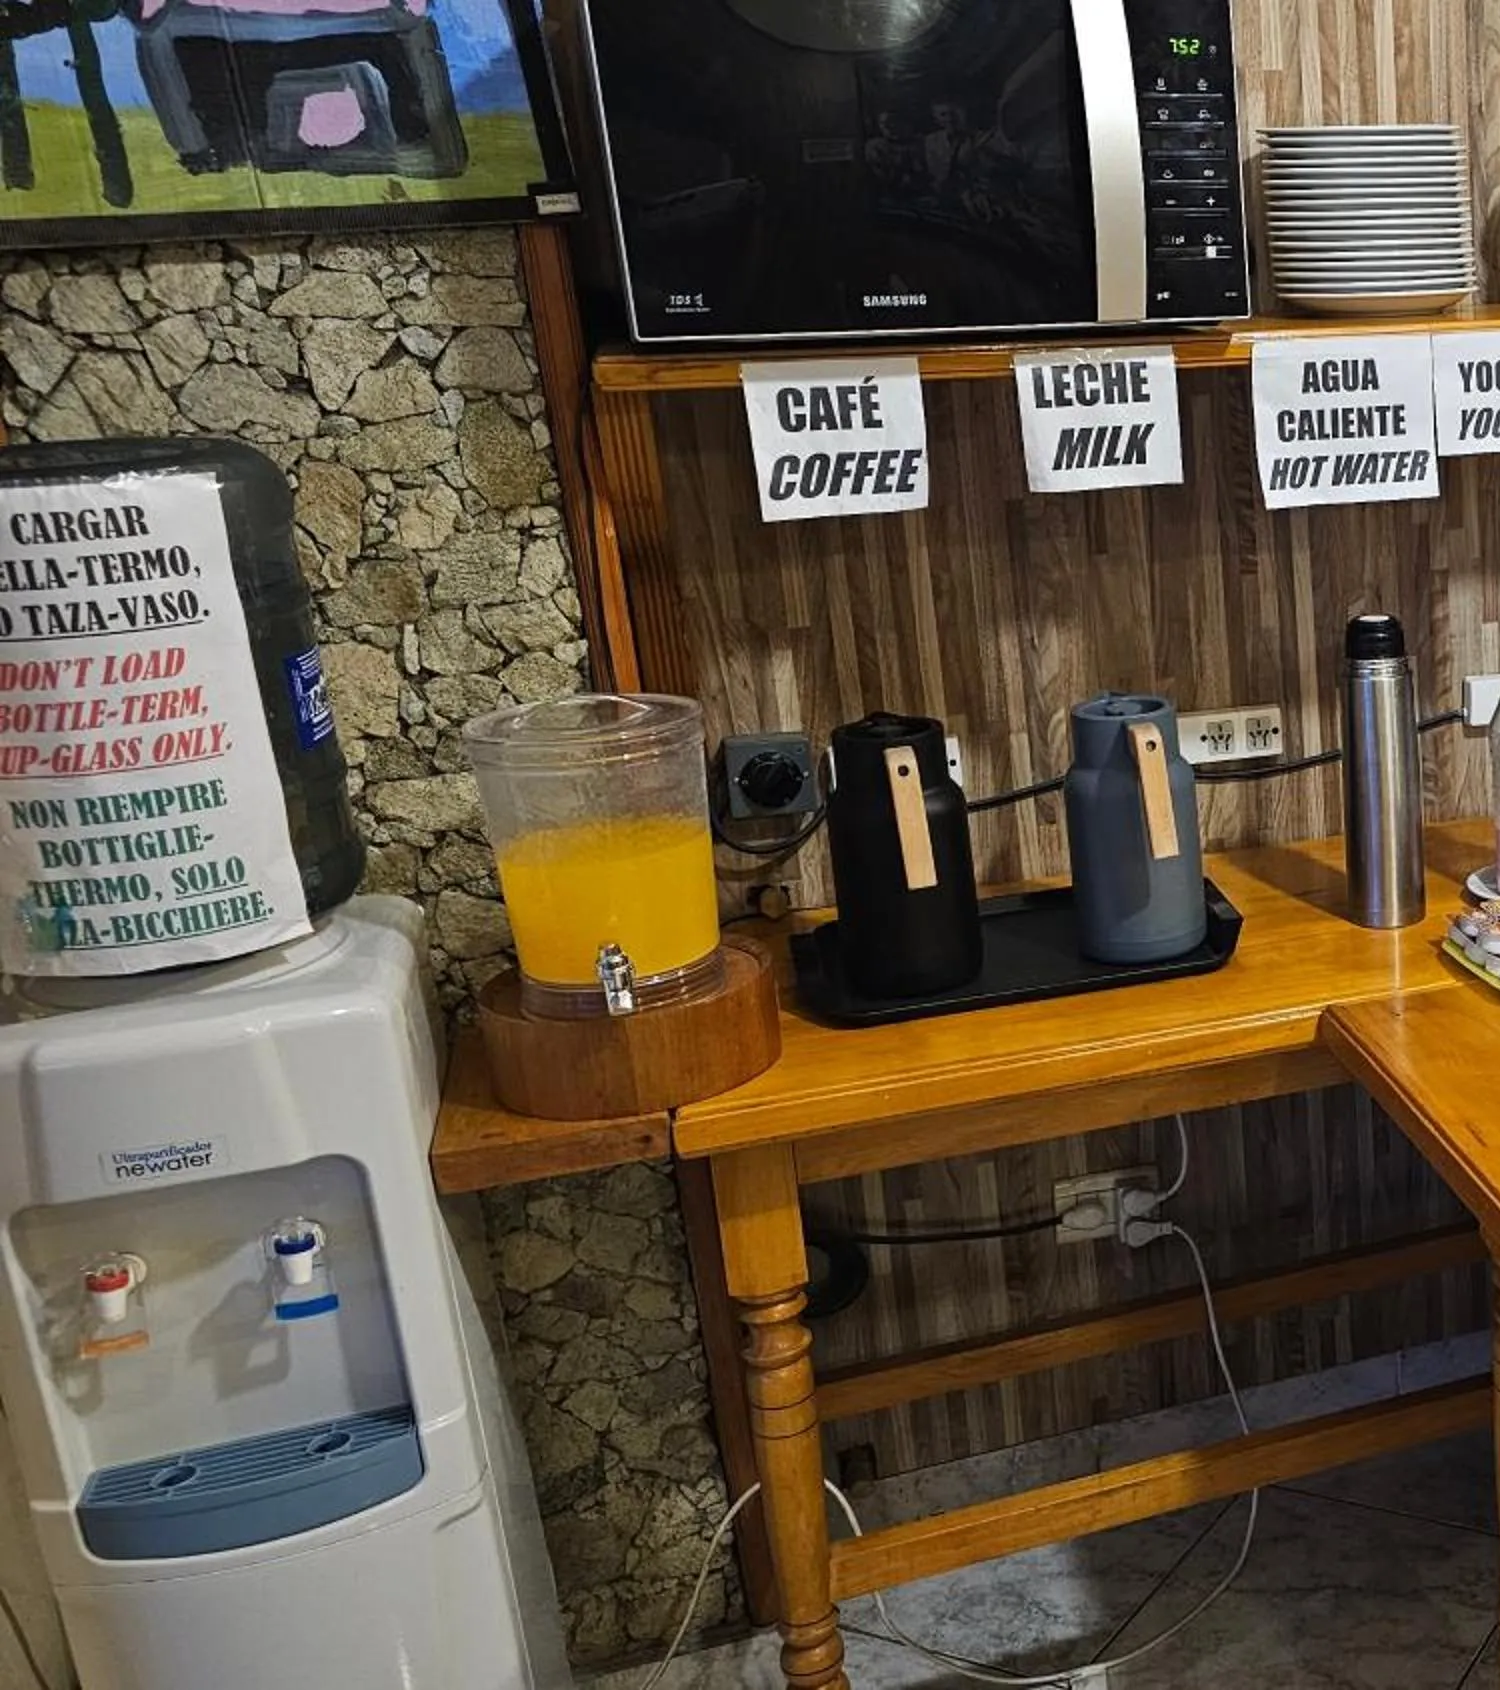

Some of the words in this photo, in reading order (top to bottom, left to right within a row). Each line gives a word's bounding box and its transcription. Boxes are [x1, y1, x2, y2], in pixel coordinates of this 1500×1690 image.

[863, 294, 927, 307] SAMSUNG
[1032, 361, 1150, 409] LECHE
[1302, 358, 1379, 393] AGUA
[776, 376, 884, 432] CAFÉ
[1277, 404, 1406, 442] CALIENTE
[1053, 423, 1155, 471] MILK
[769, 449, 922, 501] COFFEE
[1269, 455, 1328, 490] HOT
[1332, 449, 1430, 486] WATER
[10, 505, 150, 545] CARGAR
[21, 589, 210, 636] TAZA-VASO.
[0, 656, 95, 692] DON'T
[101, 647, 185, 686] LOAD
[152, 721, 233, 764] ONLY.
[8, 799, 68, 829] NON
[75, 778, 228, 826] RIEMPIRE
[38, 823, 215, 868] BOTTIGLIE-
[171, 855, 247, 896] SOLO
[115, 1152, 213, 1179] newater
